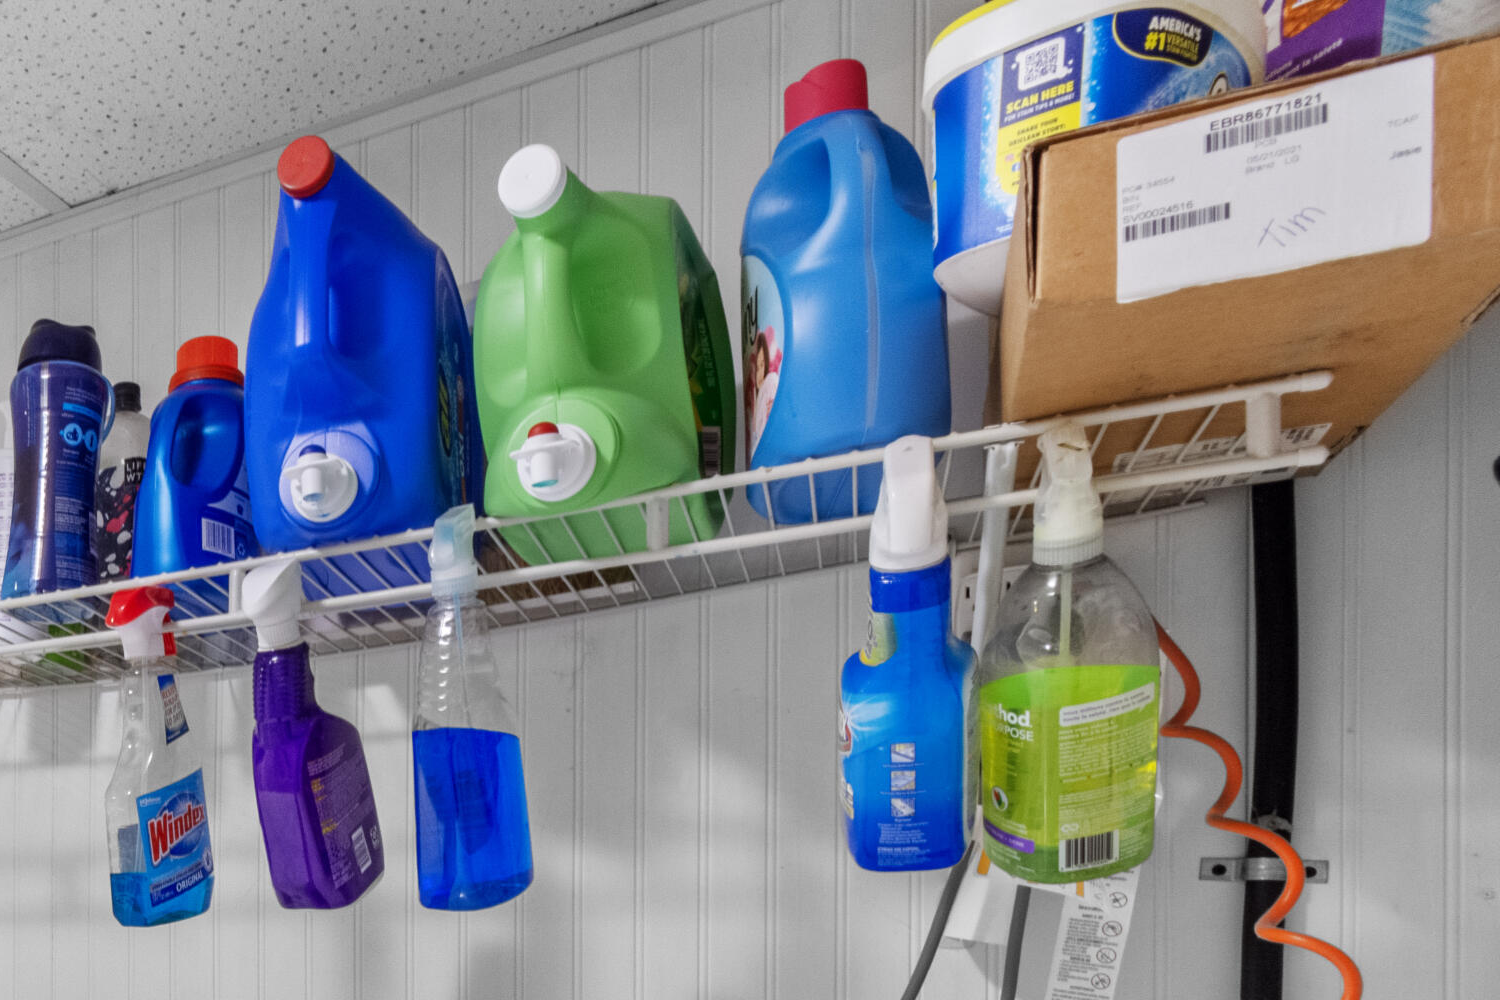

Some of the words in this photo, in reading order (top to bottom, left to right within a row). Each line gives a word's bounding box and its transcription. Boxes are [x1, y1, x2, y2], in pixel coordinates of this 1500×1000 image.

[1144, 32, 1166, 51] #1
[1149, 16, 1201, 42] AMERICA'S
[1006, 93, 1039, 115] SCAN
[1041, 80, 1075, 101] HERE
[1210, 92, 1321, 131] EBR86771821
[148, 803, 205, 867] Windex
